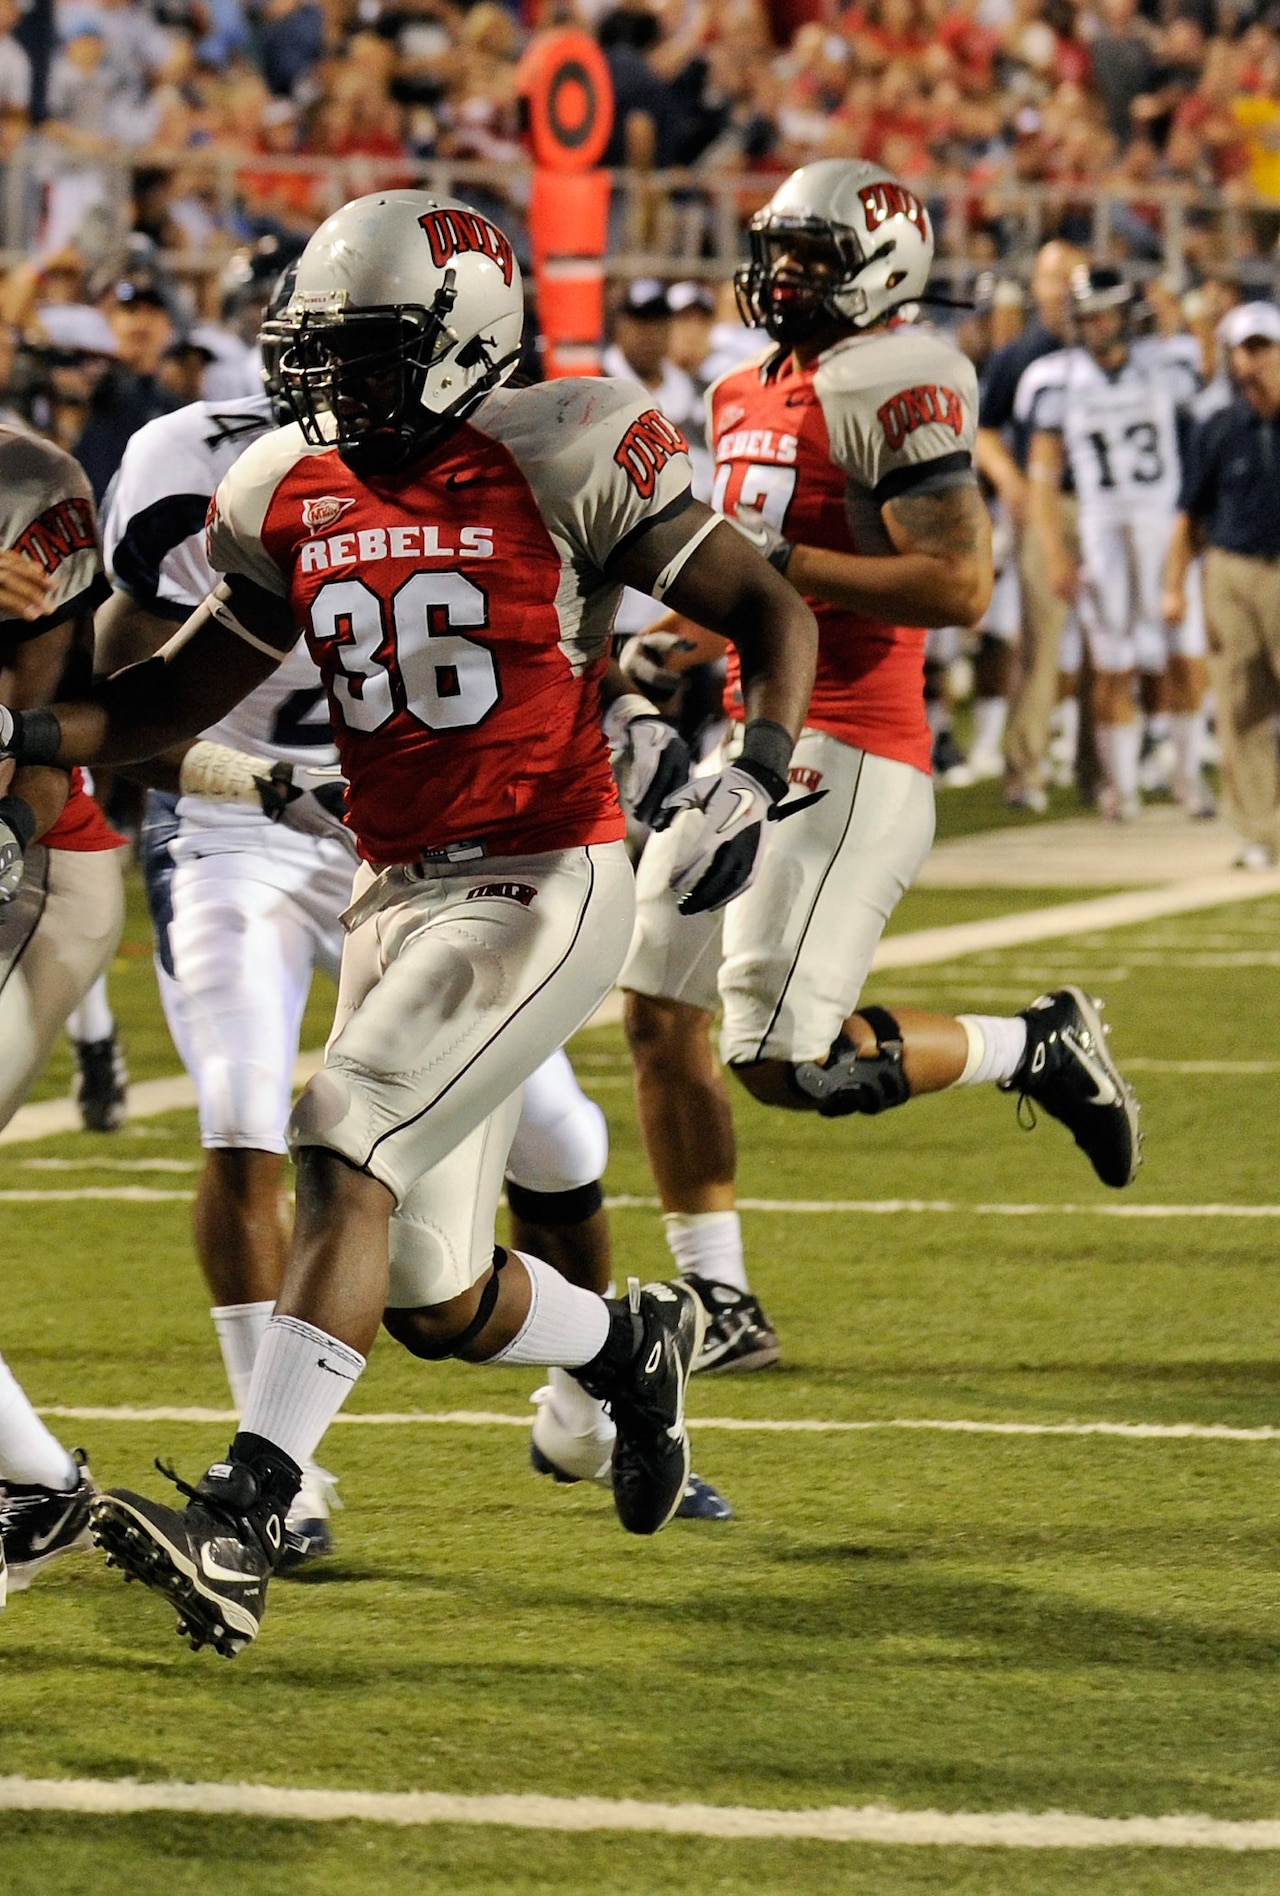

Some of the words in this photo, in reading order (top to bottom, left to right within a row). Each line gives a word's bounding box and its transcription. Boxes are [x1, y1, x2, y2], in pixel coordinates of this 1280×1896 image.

[417, 209, 514, 288] UNLV
[876, 384, 963, 449] UNLV
[1088, 421, 1166, 489] 13
[300, 525, 495, 574] REBELS
[309, 569, 502, 734] 36
